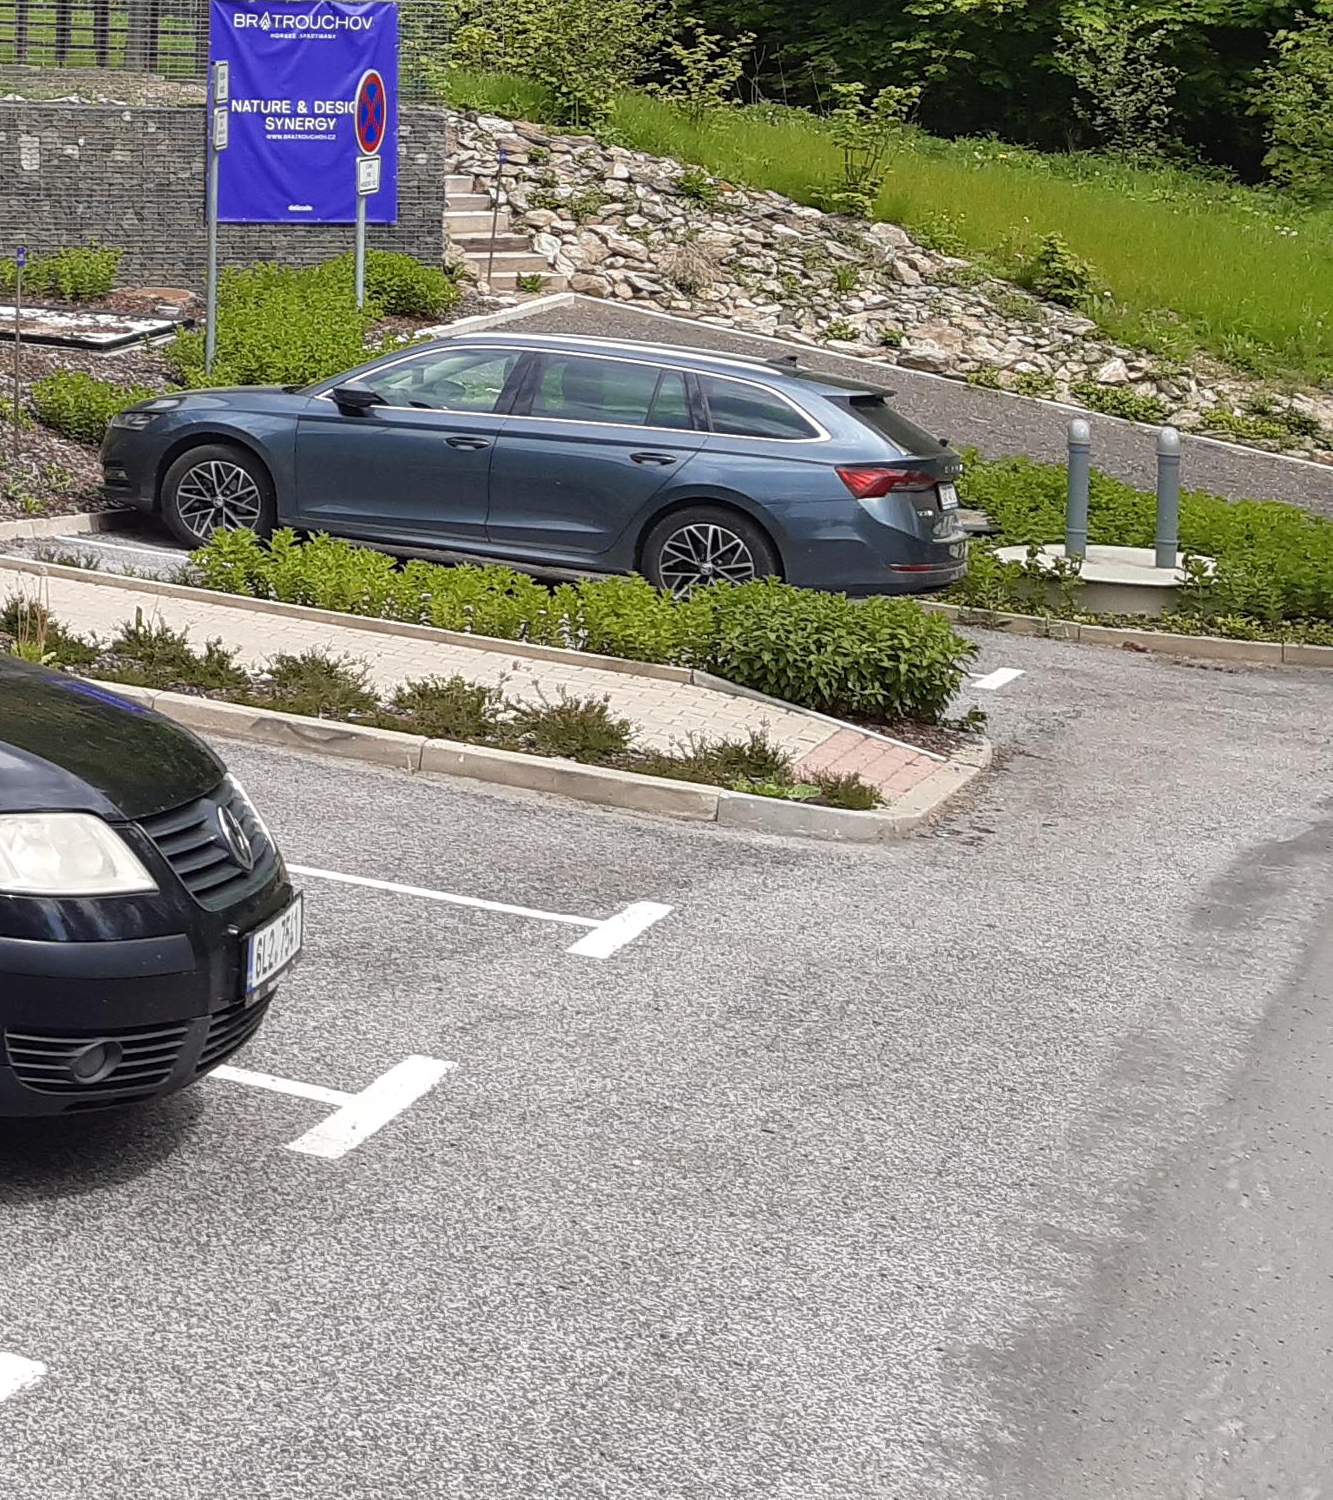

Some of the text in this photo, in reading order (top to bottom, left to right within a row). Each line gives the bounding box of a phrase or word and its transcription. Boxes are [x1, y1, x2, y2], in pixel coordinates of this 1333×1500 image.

[233, 11, 373, 31] BRATROUCHOV
[231, 99, 291, 113] NATURE
[296, 100, 308, 114] &
[264, 117, 337, 131] SYNERGY
